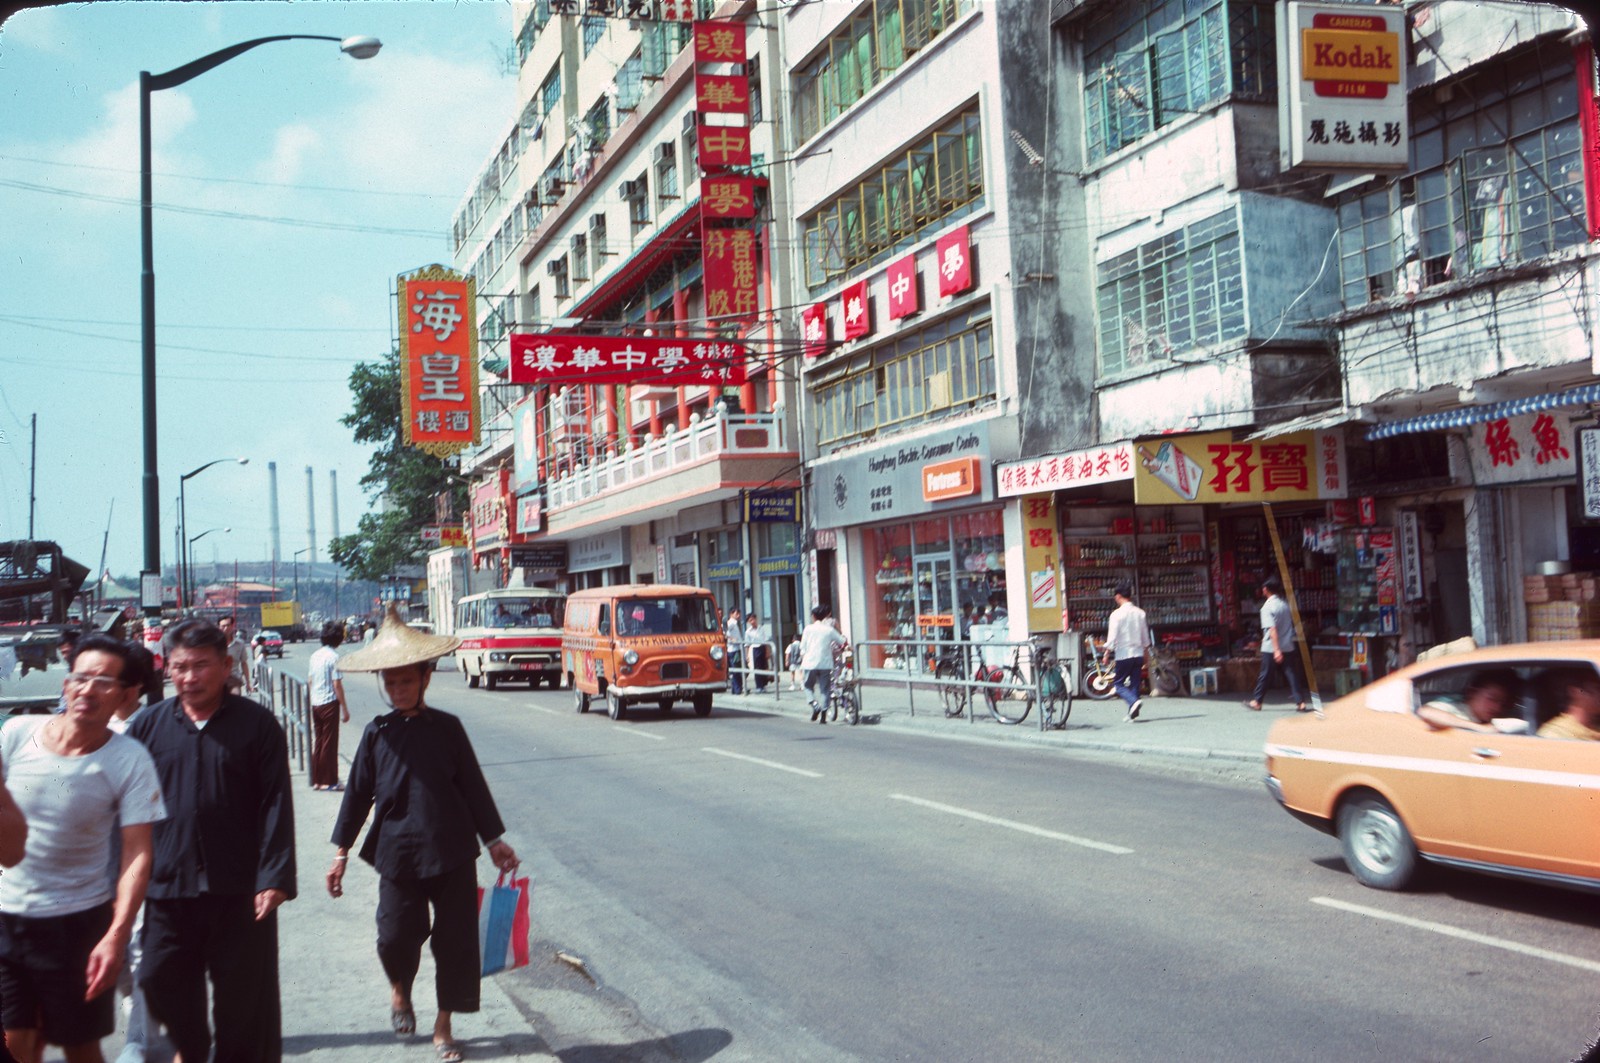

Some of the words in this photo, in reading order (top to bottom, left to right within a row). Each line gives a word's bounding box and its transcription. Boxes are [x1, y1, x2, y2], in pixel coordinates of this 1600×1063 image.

[1329, 17, 1373, 28] CAMERAS
[1313, 42, 1393, 70] Kodak
[1337, 84, 1367, 95] FILM
[697, 29, 750, 214] 漢華中學
[705, 230, 731, 316] 分校
[731, 230, 757, 314] 香港仔
[411, 289, 466, 403] 海皇
[522, 344, 691, 374] 漢華中學
[652, 636, 675, 646] KING
[676, 635, 707, 645] QUEEN
